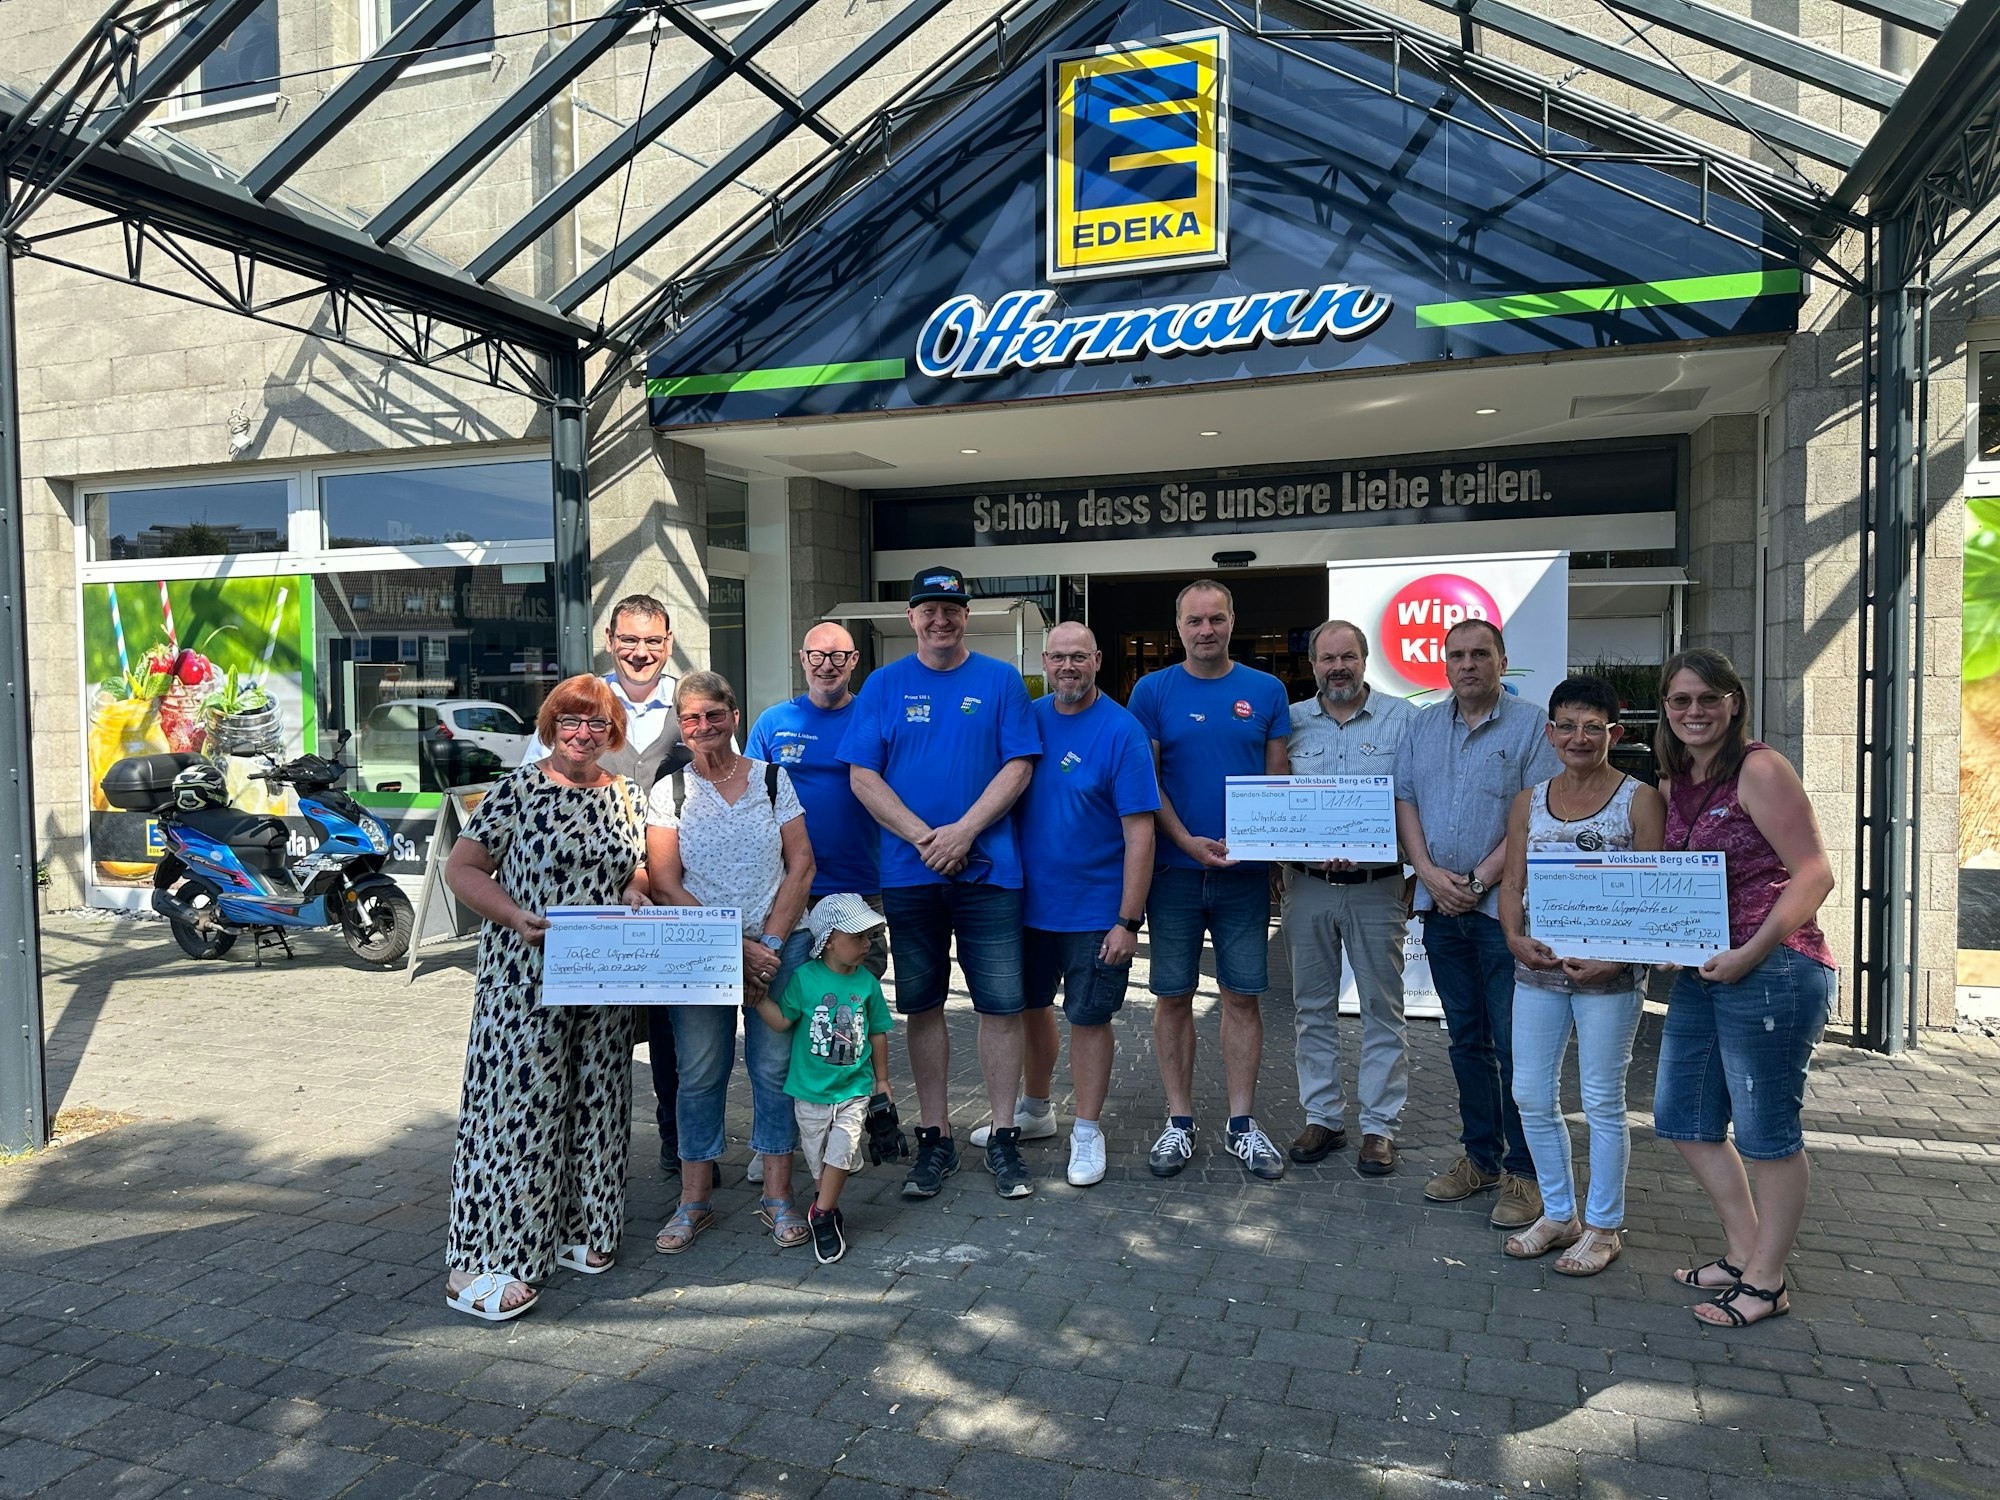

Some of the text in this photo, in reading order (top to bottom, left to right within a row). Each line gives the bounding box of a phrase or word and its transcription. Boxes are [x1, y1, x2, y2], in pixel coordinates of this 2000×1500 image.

[1072, 210, 1201, 249] EDEKA
[916, 283, 1391, 378] Offermann
[973, 461, 1553, 535] Schön, dass Sie unsere Liebe teilen.
[1401, 638, 1446, 664] Ki
[1294, 777, 1372, 786] Volksbank Berg eG
[1231, 791, 1285, 799] Spenden-Scheck
[1608, 854, 1699, 866] Volksbank Berg eG
[1534, 872, 1598, 881] Spenden-Scheck
[1610, 881, 1625, 889] EUR
[631, 908, 718, 918] Volksbank Berg eG
[552, 923, 619, 932] Spenden-Scheck
